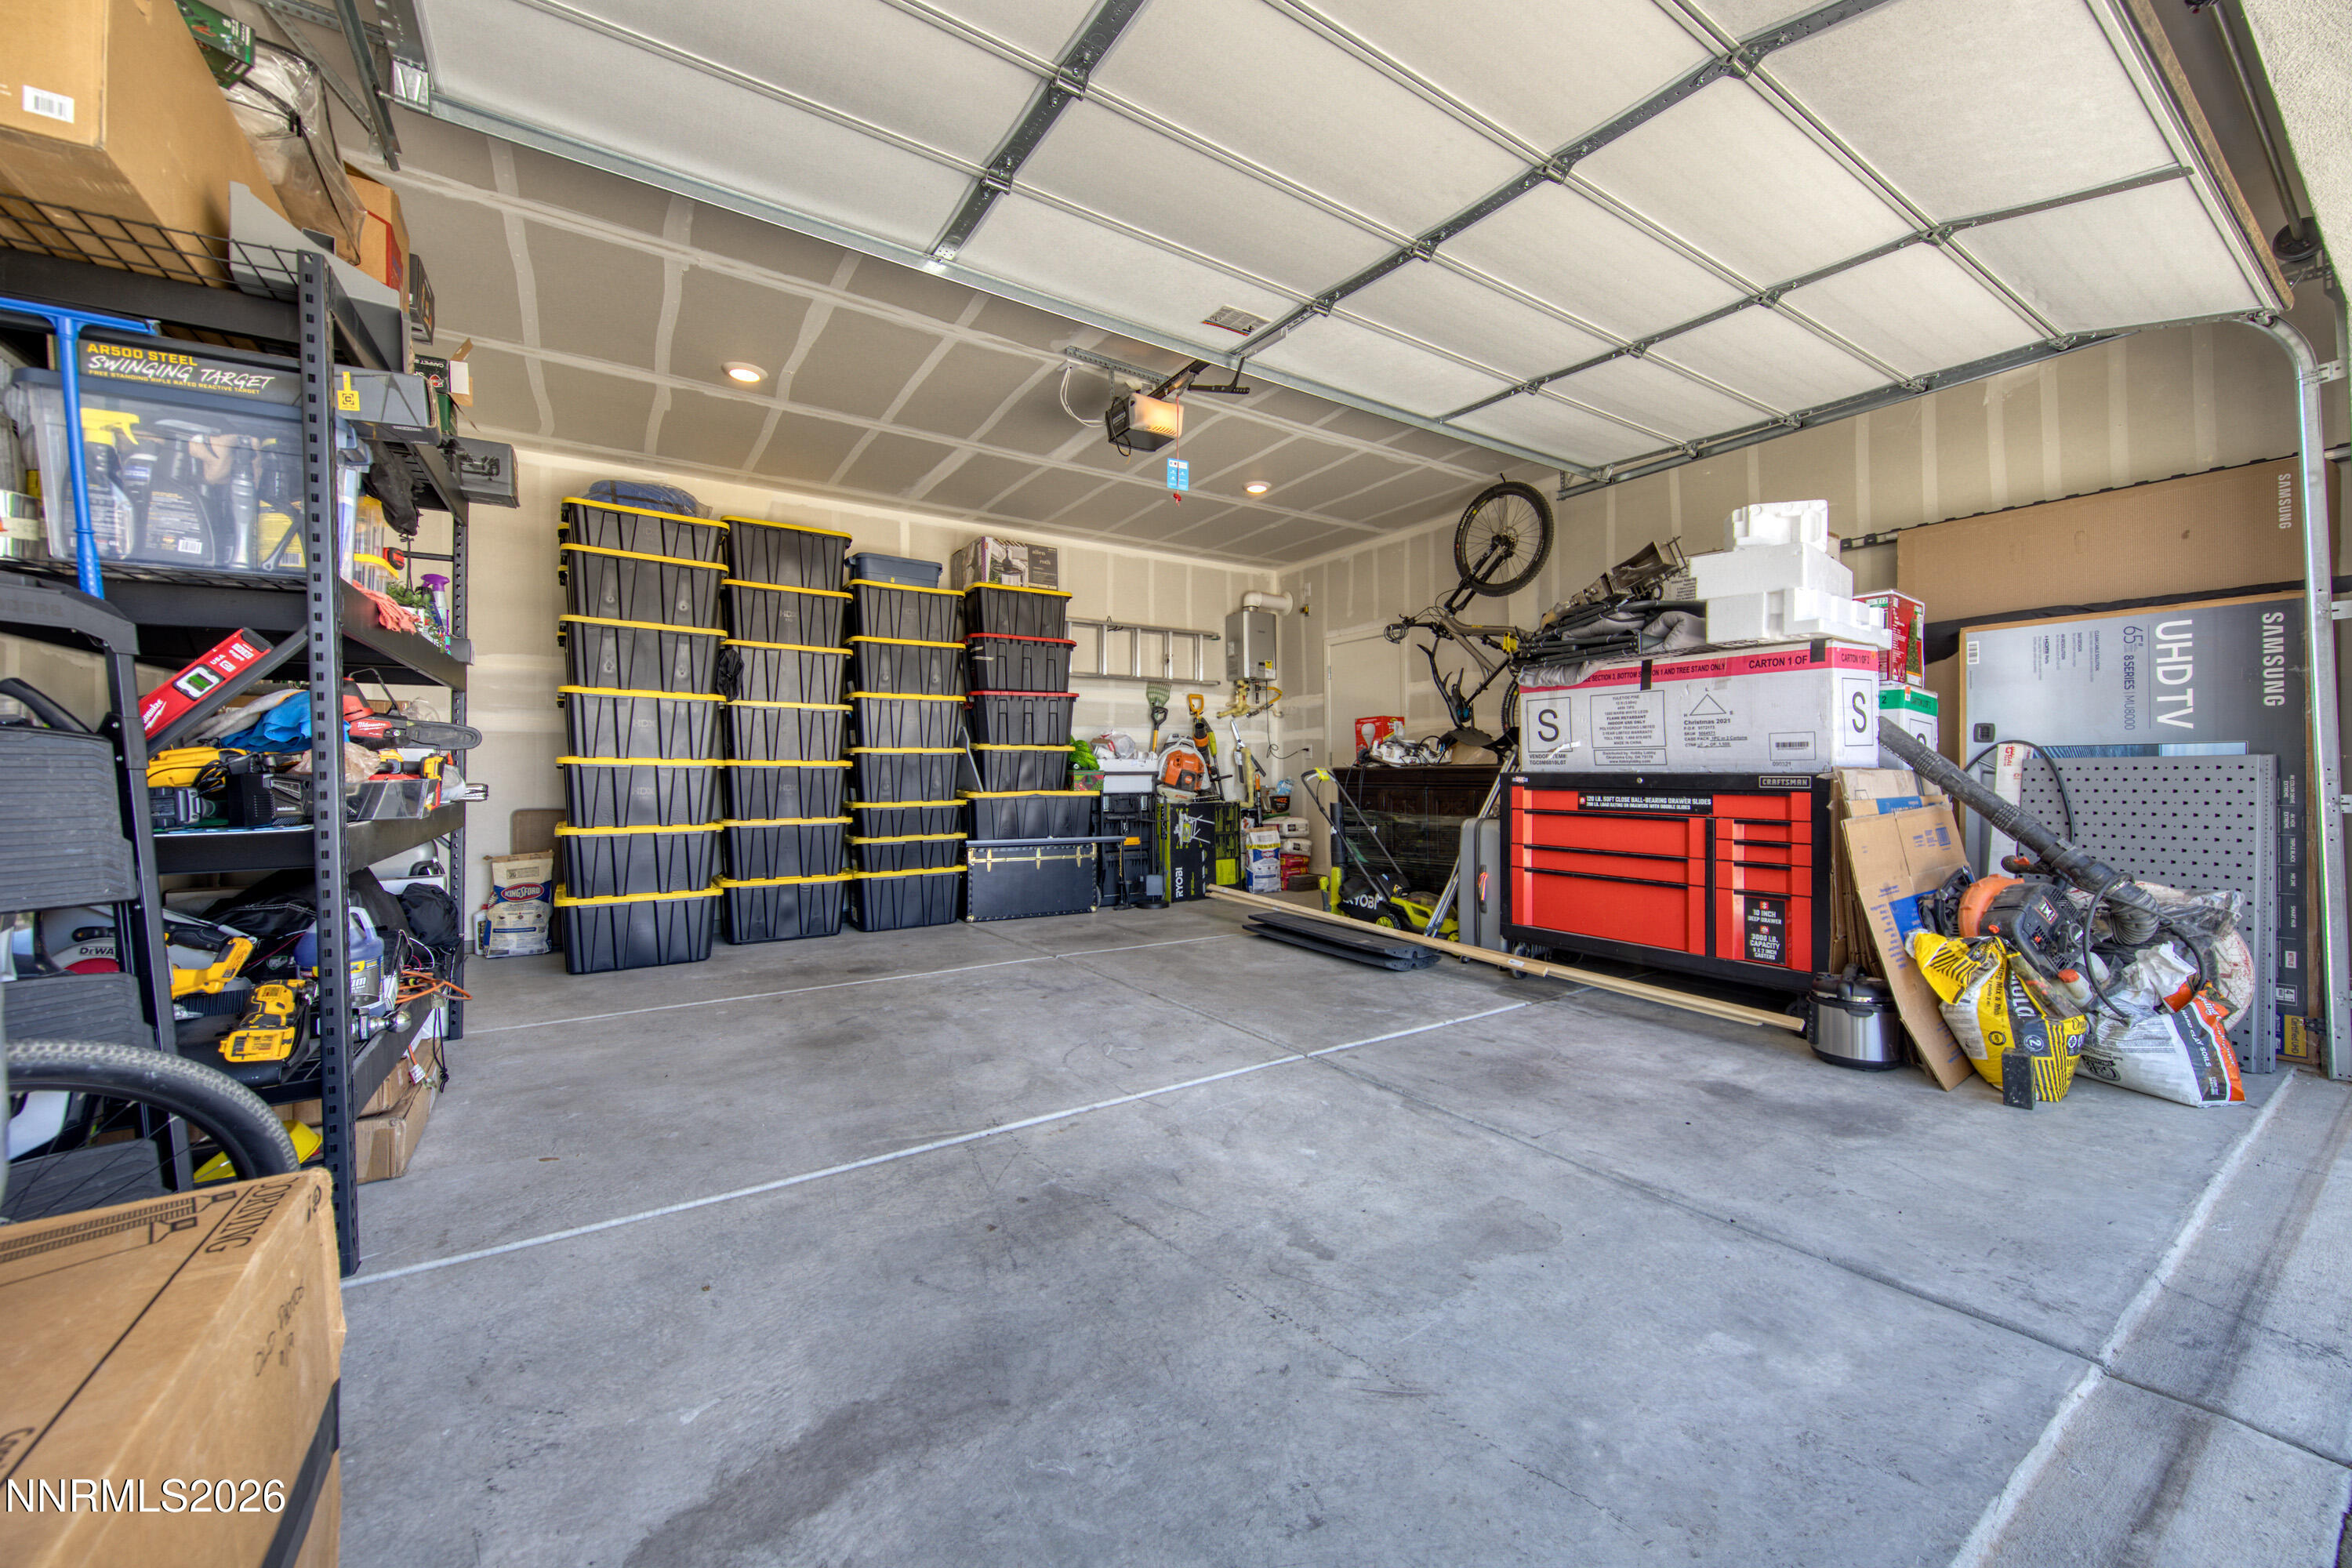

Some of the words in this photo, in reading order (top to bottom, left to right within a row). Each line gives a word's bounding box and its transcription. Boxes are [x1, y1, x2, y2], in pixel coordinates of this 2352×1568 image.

[87, 343, 143, 359] AR500
[147, 350, 198, 366] STEEL
[88, 354, 194, 383] SWINGING
[200, 368, 275, 390] TARGET
[111, 372, 149, 383] STANDING
[198, 383, 233, 392] REACTIVE
[234, 387, 260, 395] TARGET
[2278, 473, 2292, 529] SAMSUNG
[210, 654, 227, 665] USA
[1841, 653, 1858, 663] CARTON
[2154, 619, 2194, 685] UHD
[2263, 612, 2285, 706] SAMSUNG
[1592, 673, 1611, 682] SECTION
[1617, 670, 1636, 680] BOTTOM
[1664, 666, 1675, 675] AND
[1676, 664, 1690, 673] TREE
[1690, 663, 1709, 673] STAND
[1710, 662, 1726, 672] ONLY
[1748, 657, 1785, 669] CARTON
[1788, 657, 1792, 666] 1
[1794, 655, 1808, 665] OF
[1882, 695, 1887, 704] 2
[2156, 688, 2194, 729] TV
[1852, 691, 1867, 733] S
[2124, 695, 2136, 731] MU8000
[1537, 709, 1559, 742] S
[504, 886, 541, 898] KINGSFORD
[1175, 866, 1184, 898] RYOBI
[1761, 909, 1777, 918] INCH
[1749, 939, 1780, 950] CAPACITY
[1754, 952, 1776, 960] CASTERS
[2180, 1009, 2194, 1027] HARD
[2190, 1029, 2205, 1046] CLAY
[2200, 1047, 2212, 1068] SOILS
[2291, 1018, 2299, 1041] Certified
[2291, 1041, 2299, 1054] UHD
